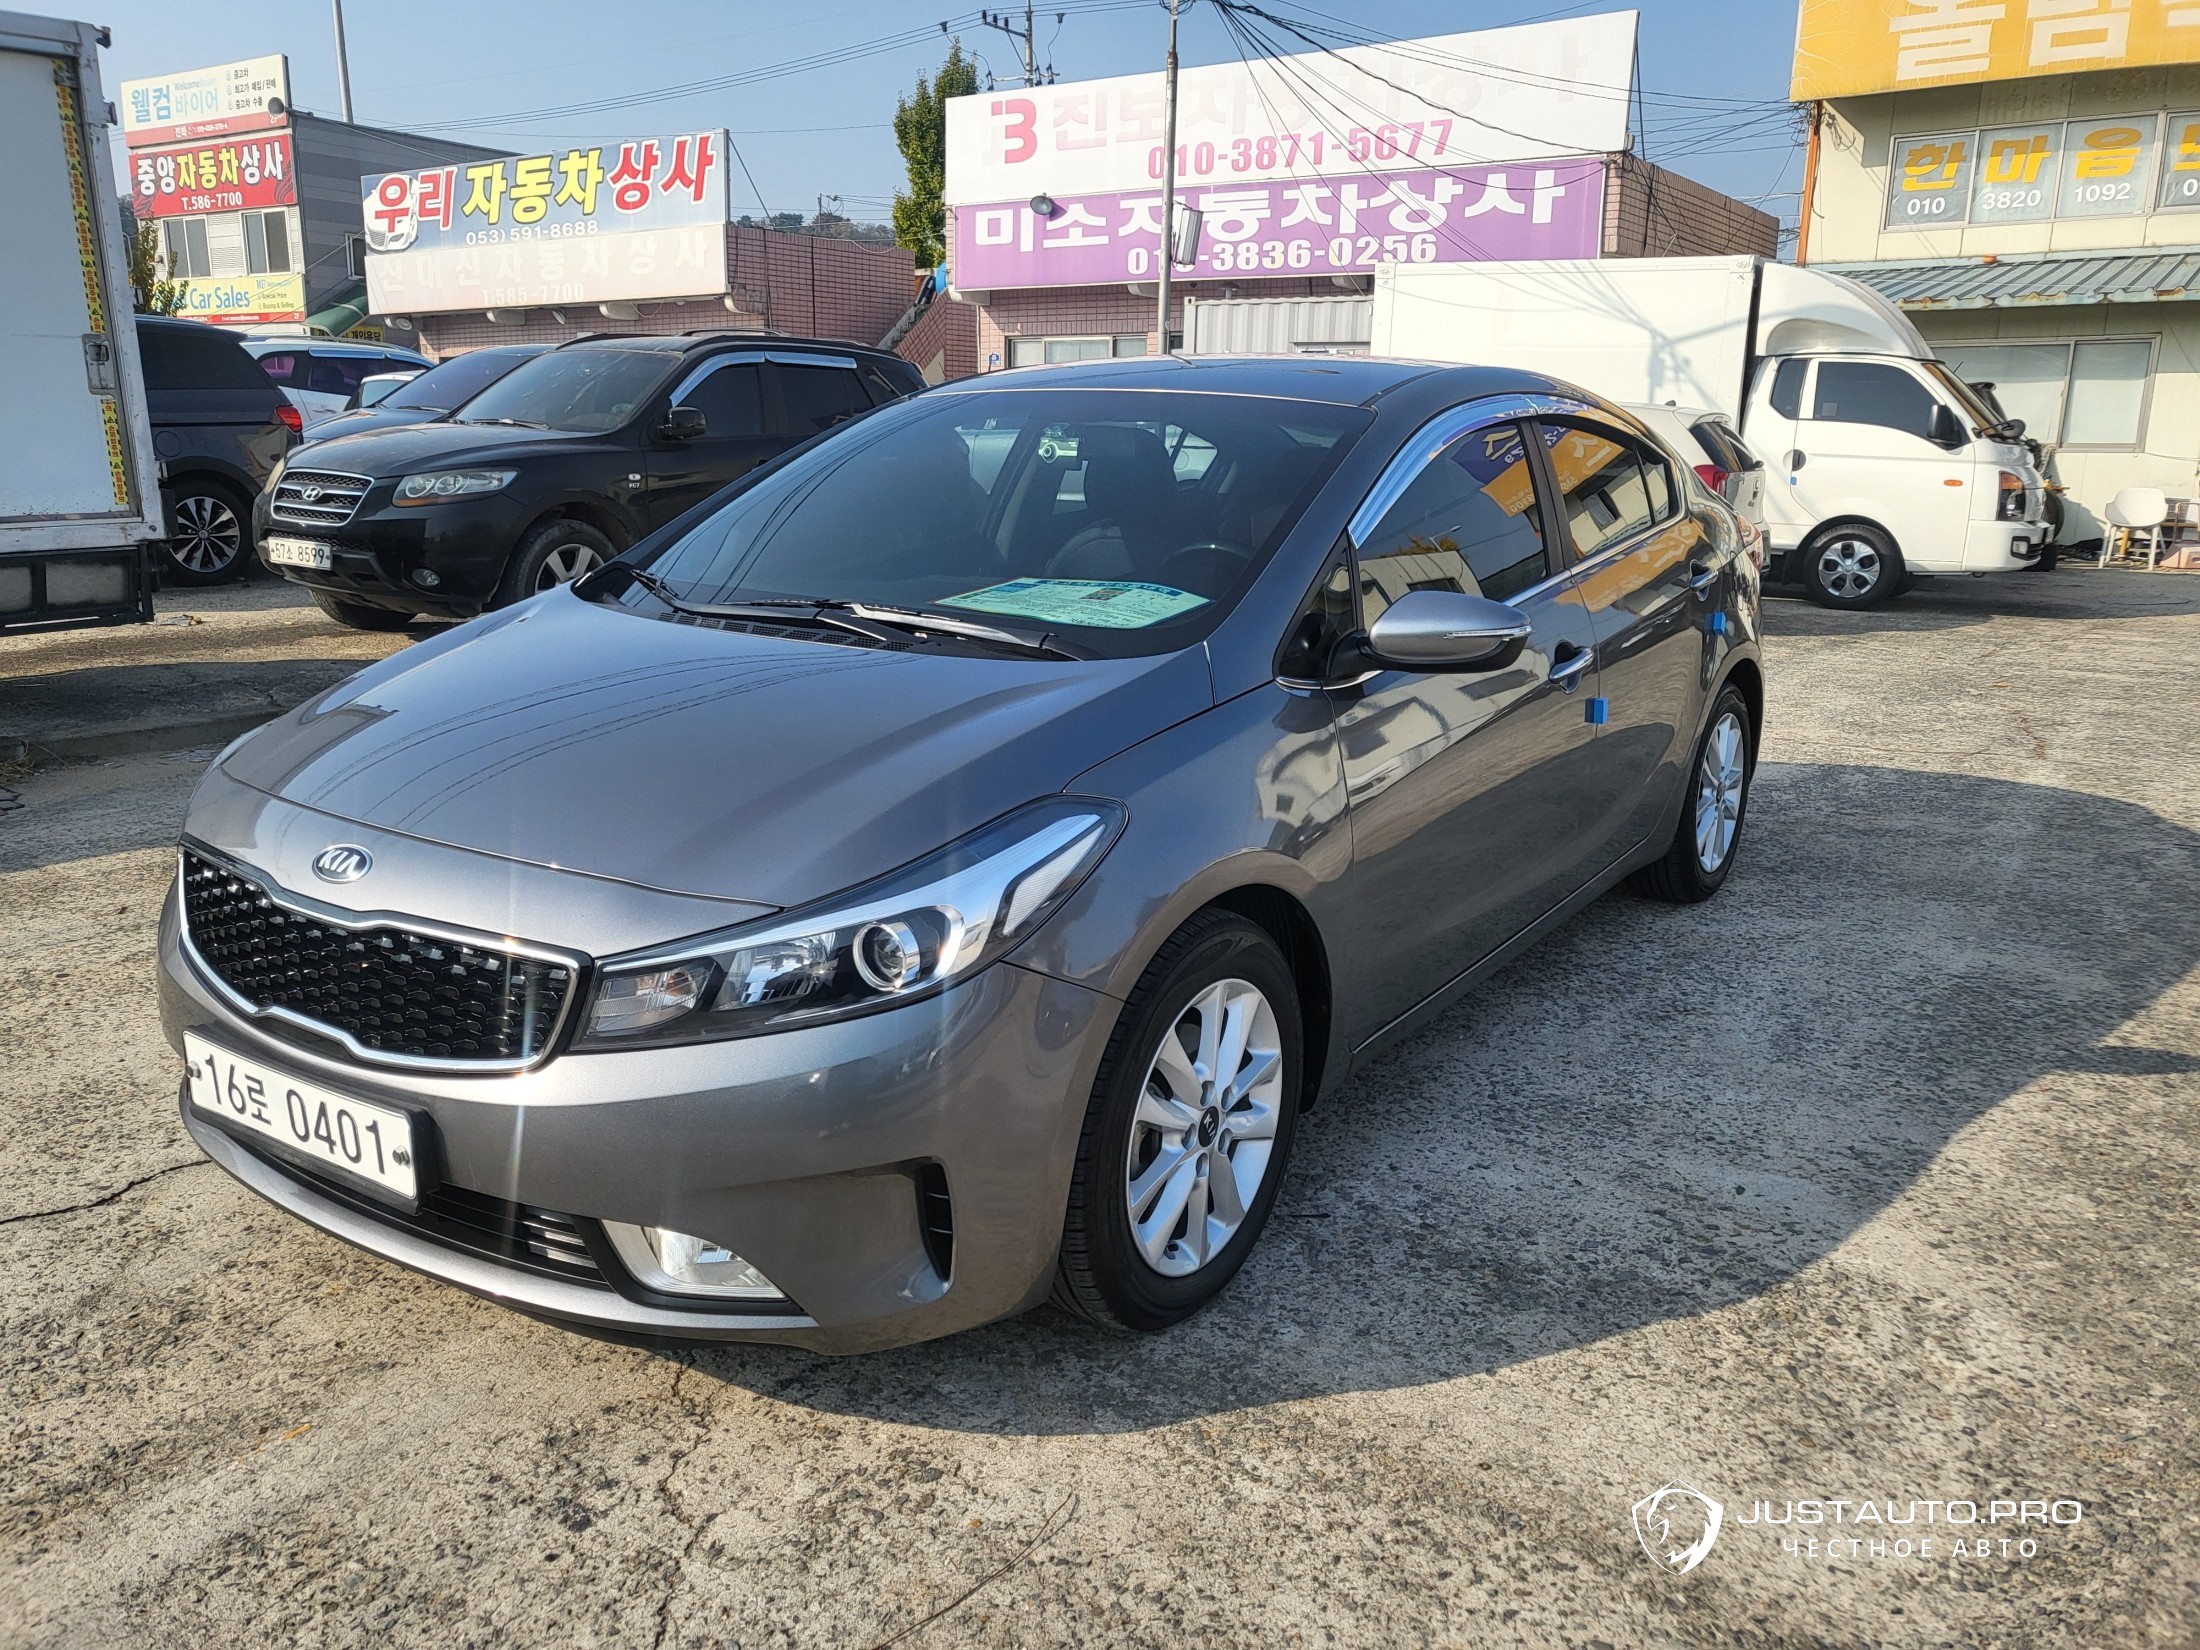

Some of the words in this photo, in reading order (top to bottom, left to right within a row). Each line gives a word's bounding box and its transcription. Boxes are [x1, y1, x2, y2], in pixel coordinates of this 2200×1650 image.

[131, 84, 172, 124] 웰컴
[175, 88, 219, 117] 바이어
[1148, 119, 1453, 180] 010-3871-5677
[137, 141, 284, 196] 중앙자동차상사
[181, 191, 242, 211] T.586-7700
[1907, 196, 1946, 217] 010
[1981, 189, 2042, 211] 3820
[2074, 182, 2132, 204] 1092
[190, 287, 212, 310] Car
[214, 285, 250, 309] Sales
[275, 543, 293, 560] 57소
[298, 546, 324, 564] 8599
[205, 1054, 272, 1126] 16로
[286, 1089, 386, 1175] 0401
